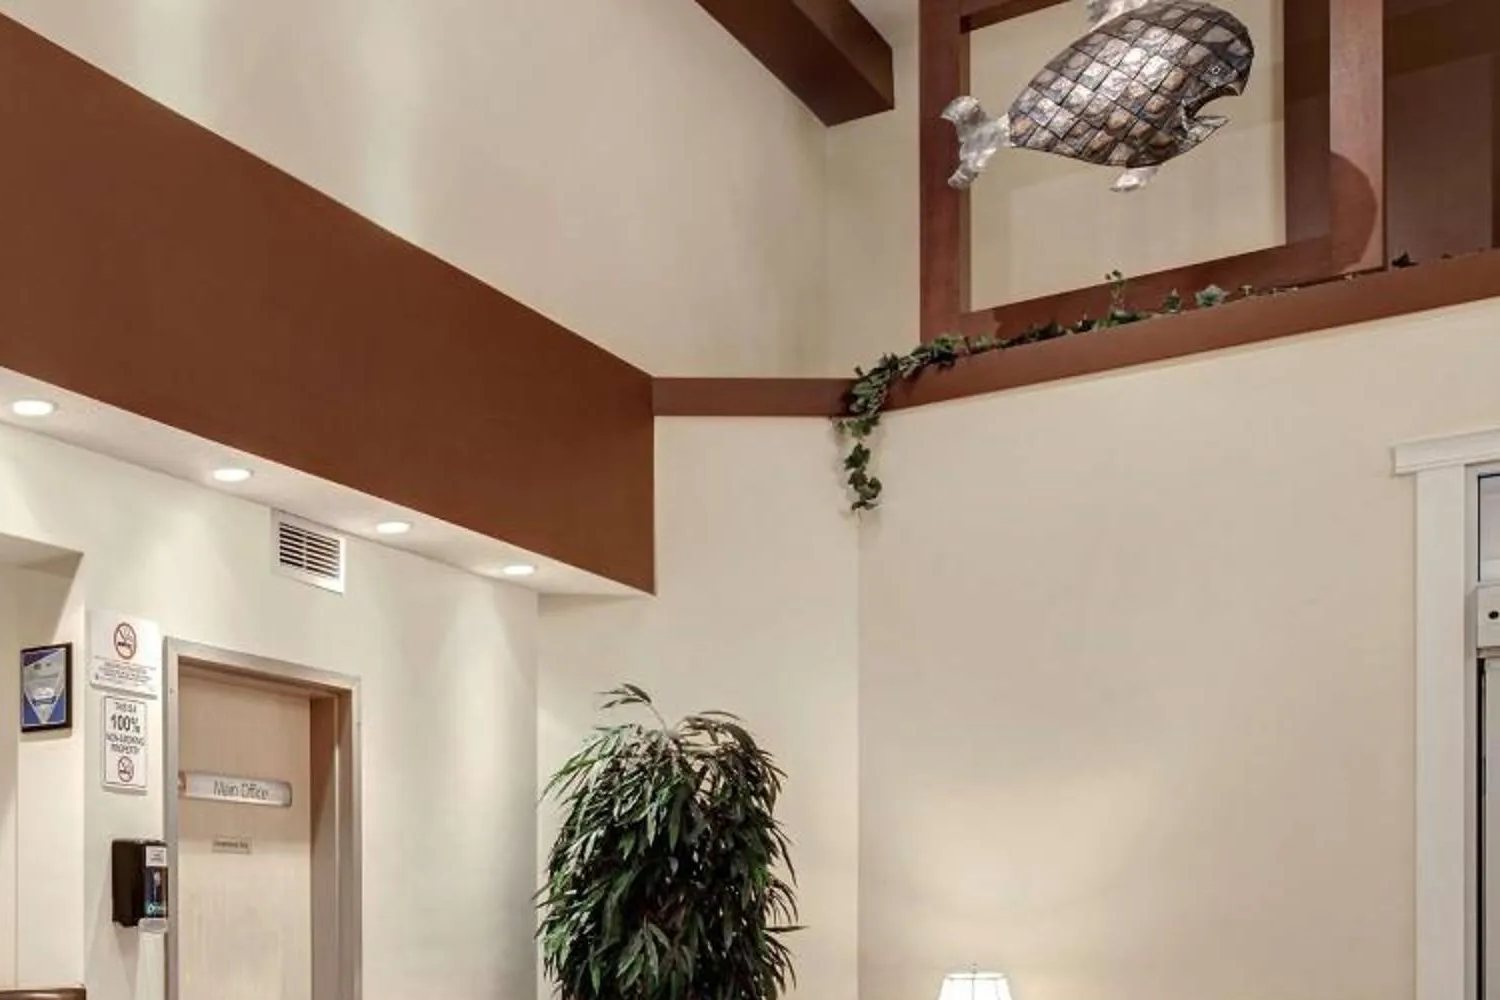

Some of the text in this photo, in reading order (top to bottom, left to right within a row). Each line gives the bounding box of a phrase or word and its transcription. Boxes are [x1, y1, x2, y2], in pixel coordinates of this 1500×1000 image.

[110, 714, 141, 733] 100%
[213, 780, 269, 800] Main Office
